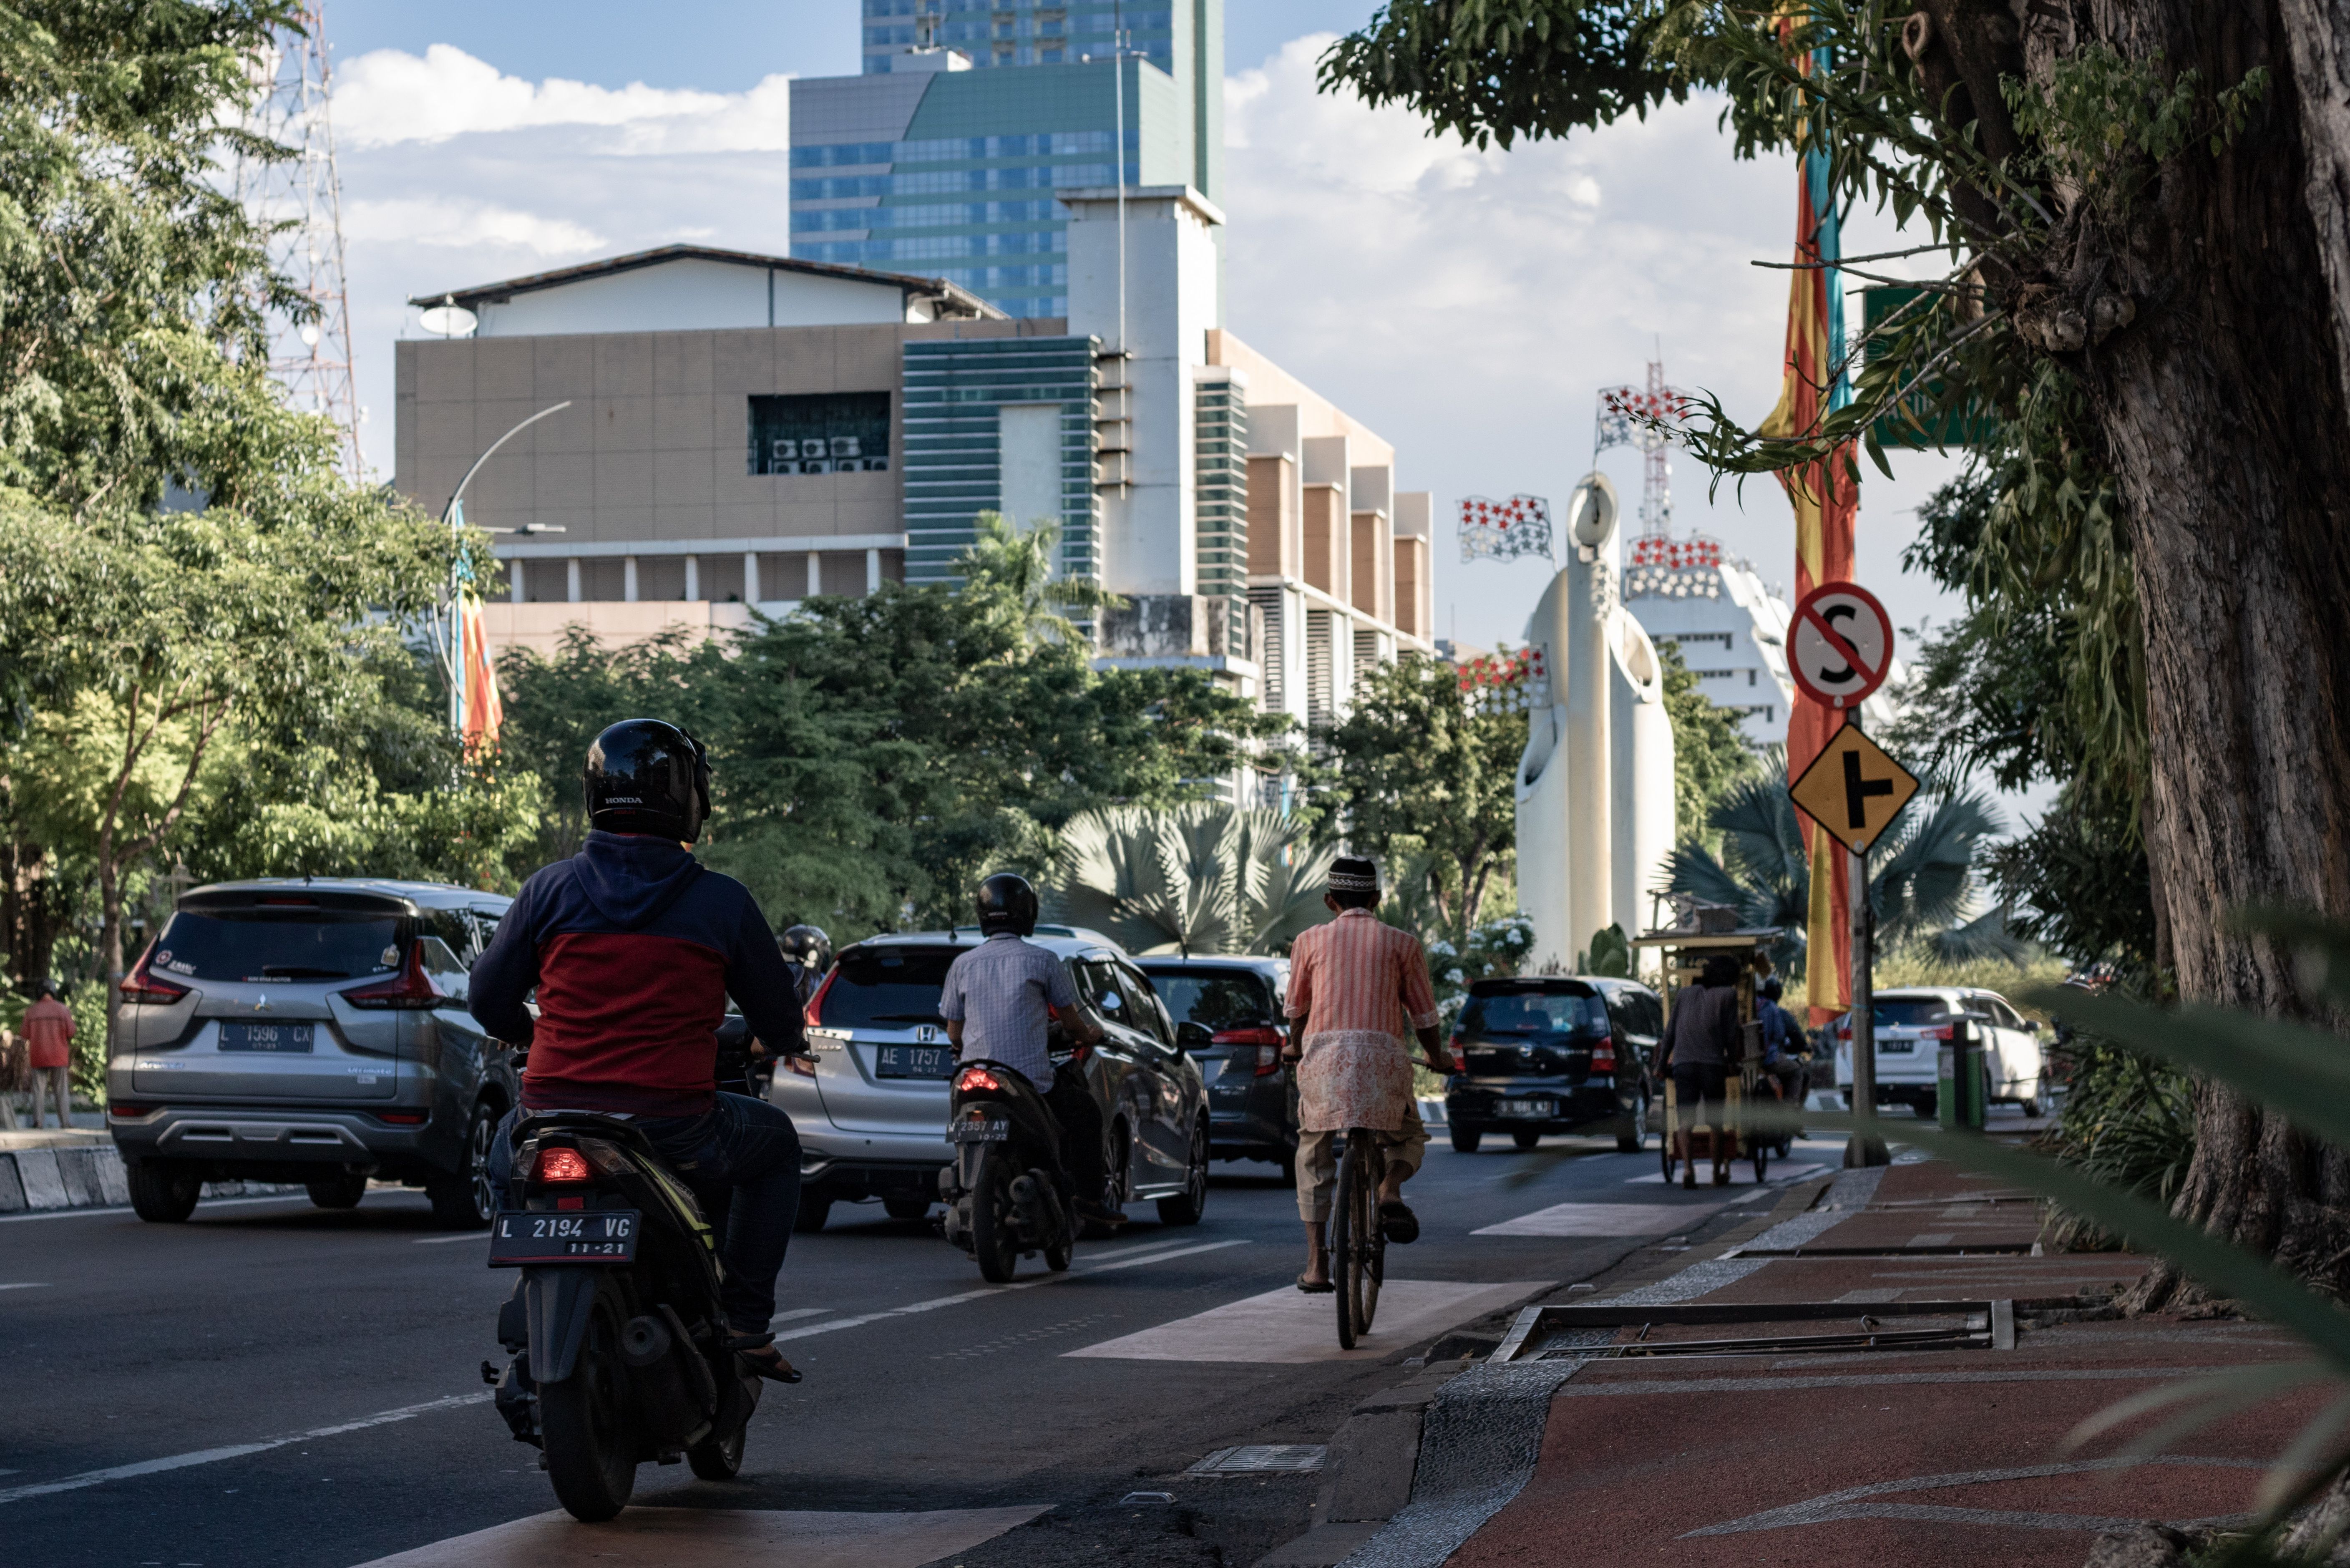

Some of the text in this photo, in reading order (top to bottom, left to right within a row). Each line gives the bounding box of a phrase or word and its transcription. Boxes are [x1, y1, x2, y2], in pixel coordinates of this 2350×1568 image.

[1819, 604, 1859, 683] S
[221, 1025, 310, 1042] L 1596 CX
[881, 1048, 898, 1065] AE
[909, 1049, 941, 1065] 1757
[948, 1120, 1007, 1133] W 2357 AY
[501, 1218, 631, 1238] L 2194 VG
